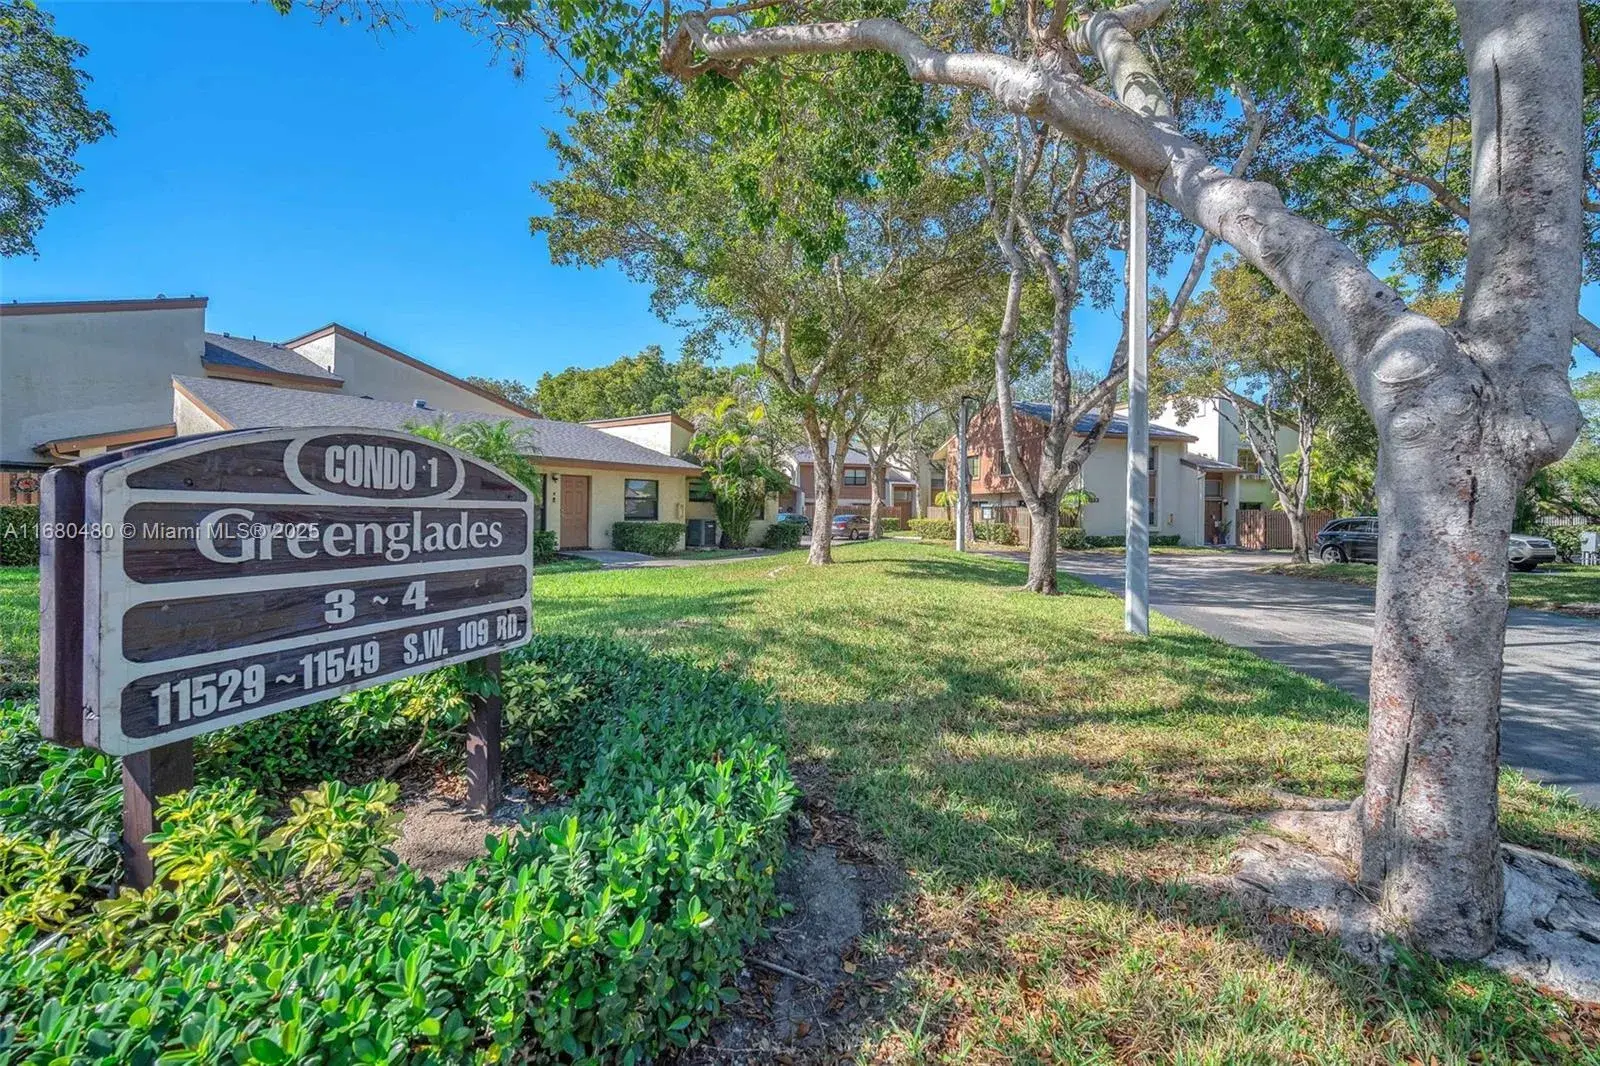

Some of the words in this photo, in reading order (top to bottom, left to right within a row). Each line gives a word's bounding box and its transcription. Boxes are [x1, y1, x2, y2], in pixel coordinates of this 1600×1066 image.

[325, 444, 416, 491] CONDO
[427, 457, 438, 487] 1
[196, 508, 503, 563] Greenglades
[324, 589, 356, 624] 3
[402, 580, 429, 610] 4
[151, 664, 265, 726] 11529
[300, 641, 380, 690] 11549
[403, 627, 448, 665] S.W.
[458, 619, 489, 651] 109
[496, 613, 522, 641] RD.
